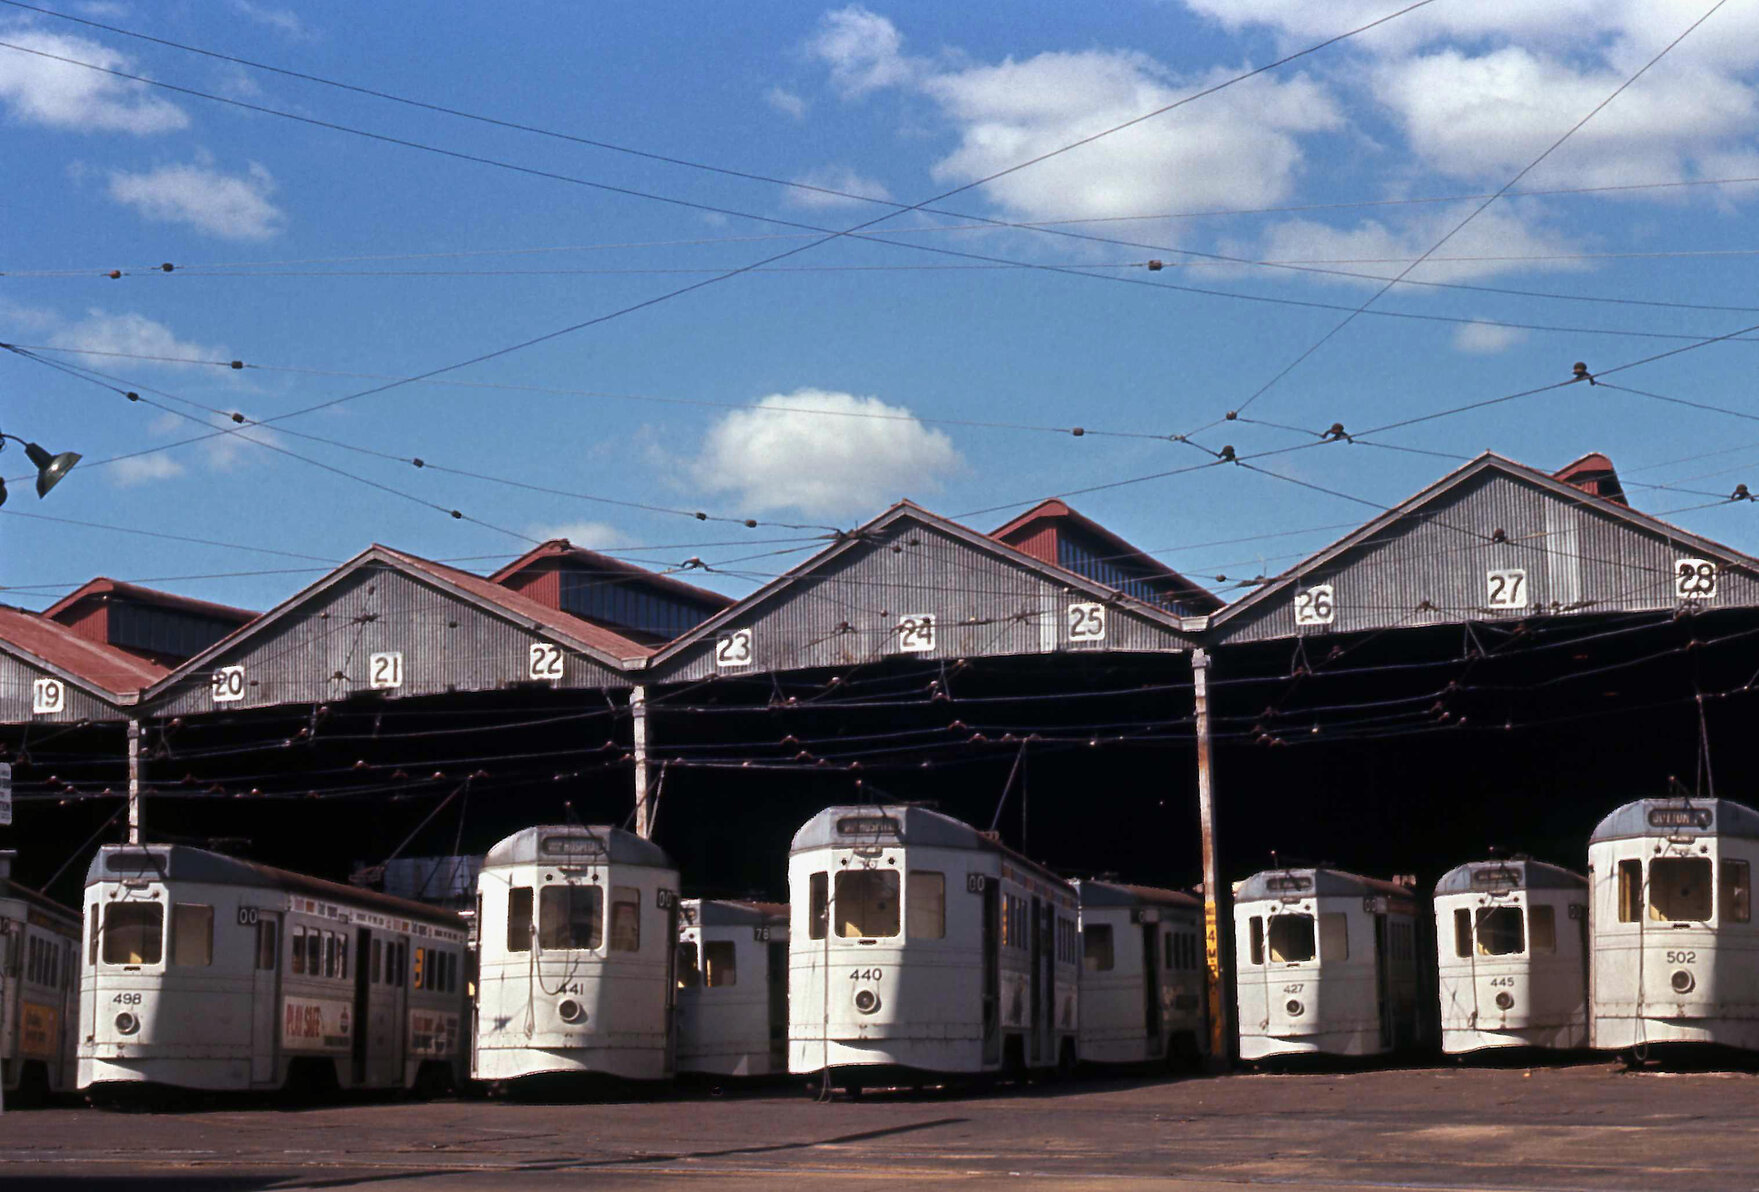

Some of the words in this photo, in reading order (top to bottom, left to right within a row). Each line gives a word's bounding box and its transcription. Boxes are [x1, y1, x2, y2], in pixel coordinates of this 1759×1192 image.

[1490, 574, 1524, 604] 27
[1679, 564, 1714, 594] 28
[1297, 590, 1332, 619] 26
[903, 619, 933, 647] 24
[1070, 607, 1104, 636] 25
[719, 633, 749, 661] 23
[374, 656, 398, 684] 21
[532, 647, 561, 675] 22
[37, 682, 59, 707] 19
[214, 670, 243, 697] 20
[658, 890, 672, 907] 00
[239, 908, 258, 924] 00
[1666, 951, 1696, 964] 502
[849, 968, 883, 982] 440
[1490, 977, 1515, 988] 445
[113, 993, 142, 1005] 498
[559, 982, 584, 996] 441
[1283, 984, 1305, 994] 427
